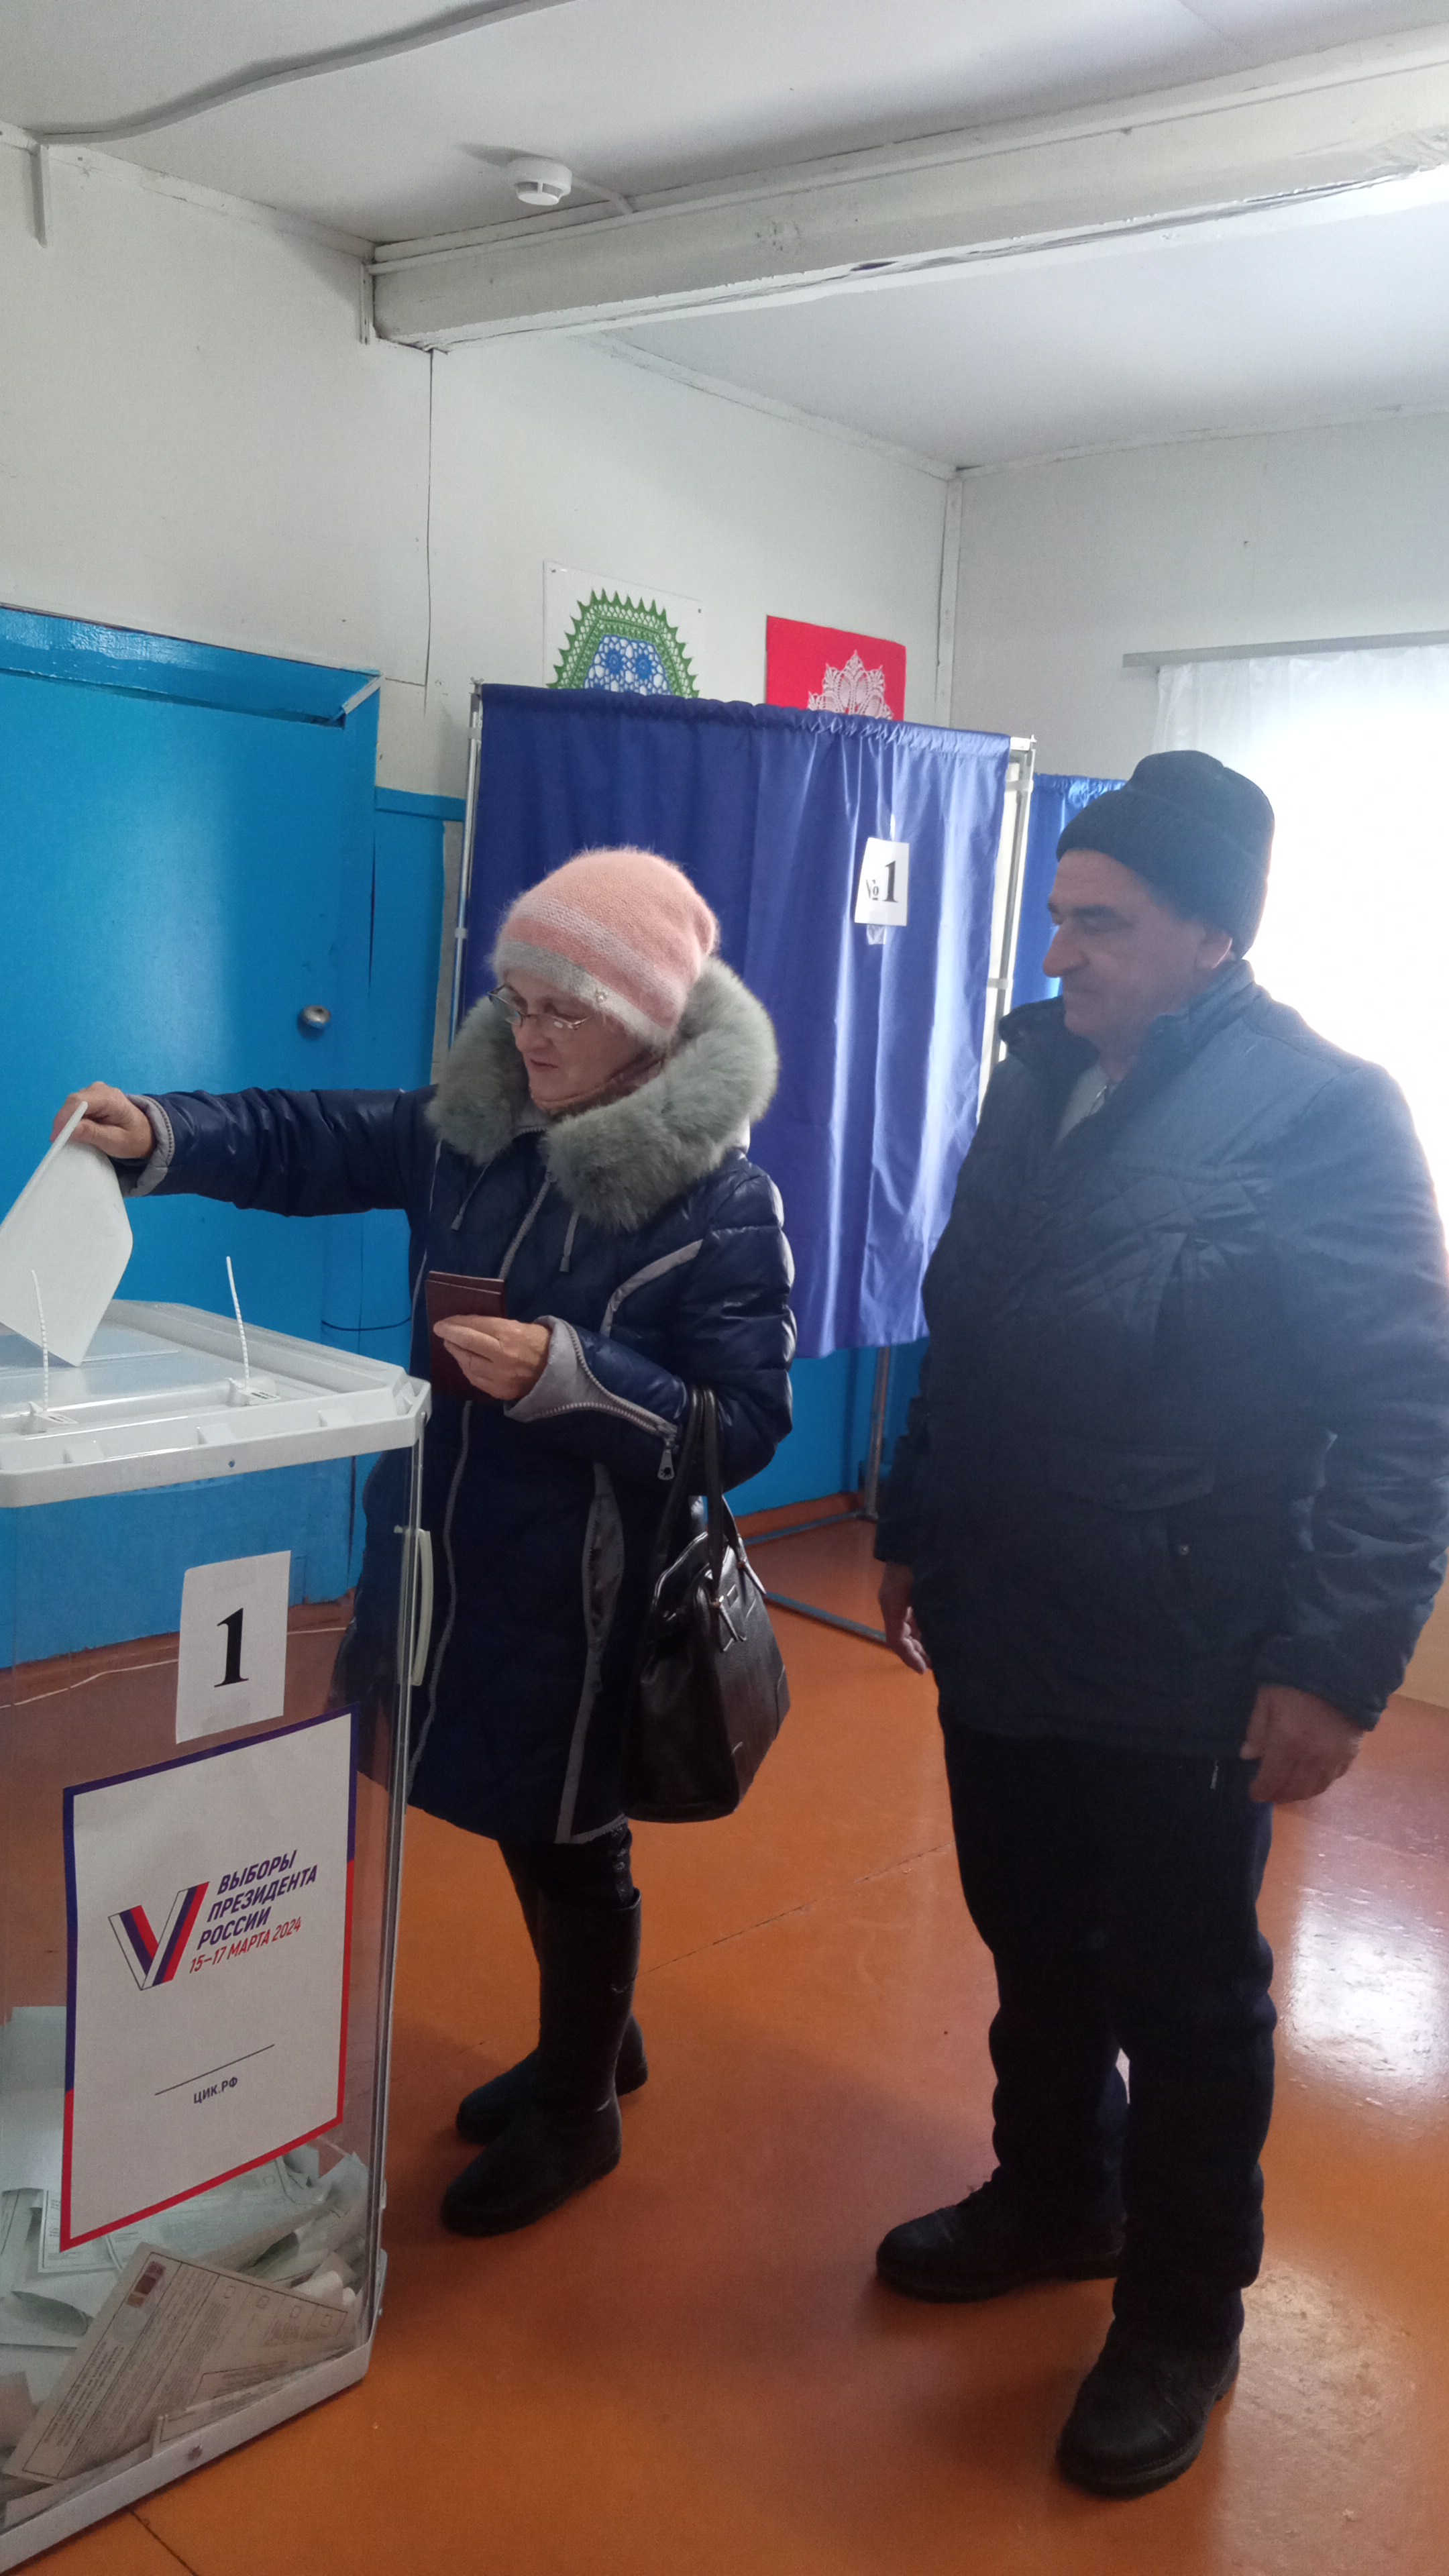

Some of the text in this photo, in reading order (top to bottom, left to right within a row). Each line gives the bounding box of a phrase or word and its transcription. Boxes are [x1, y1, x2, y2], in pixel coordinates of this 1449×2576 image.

[214, 1607, 249, 1687] 1
[207, 1864, 318, 1923] ПРЕЗИДЕНТА
[217, 1849, 297, 1895] ВЫБОРЫ
[197, 1906, 272, 1950] РОССИИ
[226, 1929, 271, 1960] МАРТА
[271, 1916, 301, 1942] 2024
[193, 2076, 237, 2104] ЦИК.РФ
